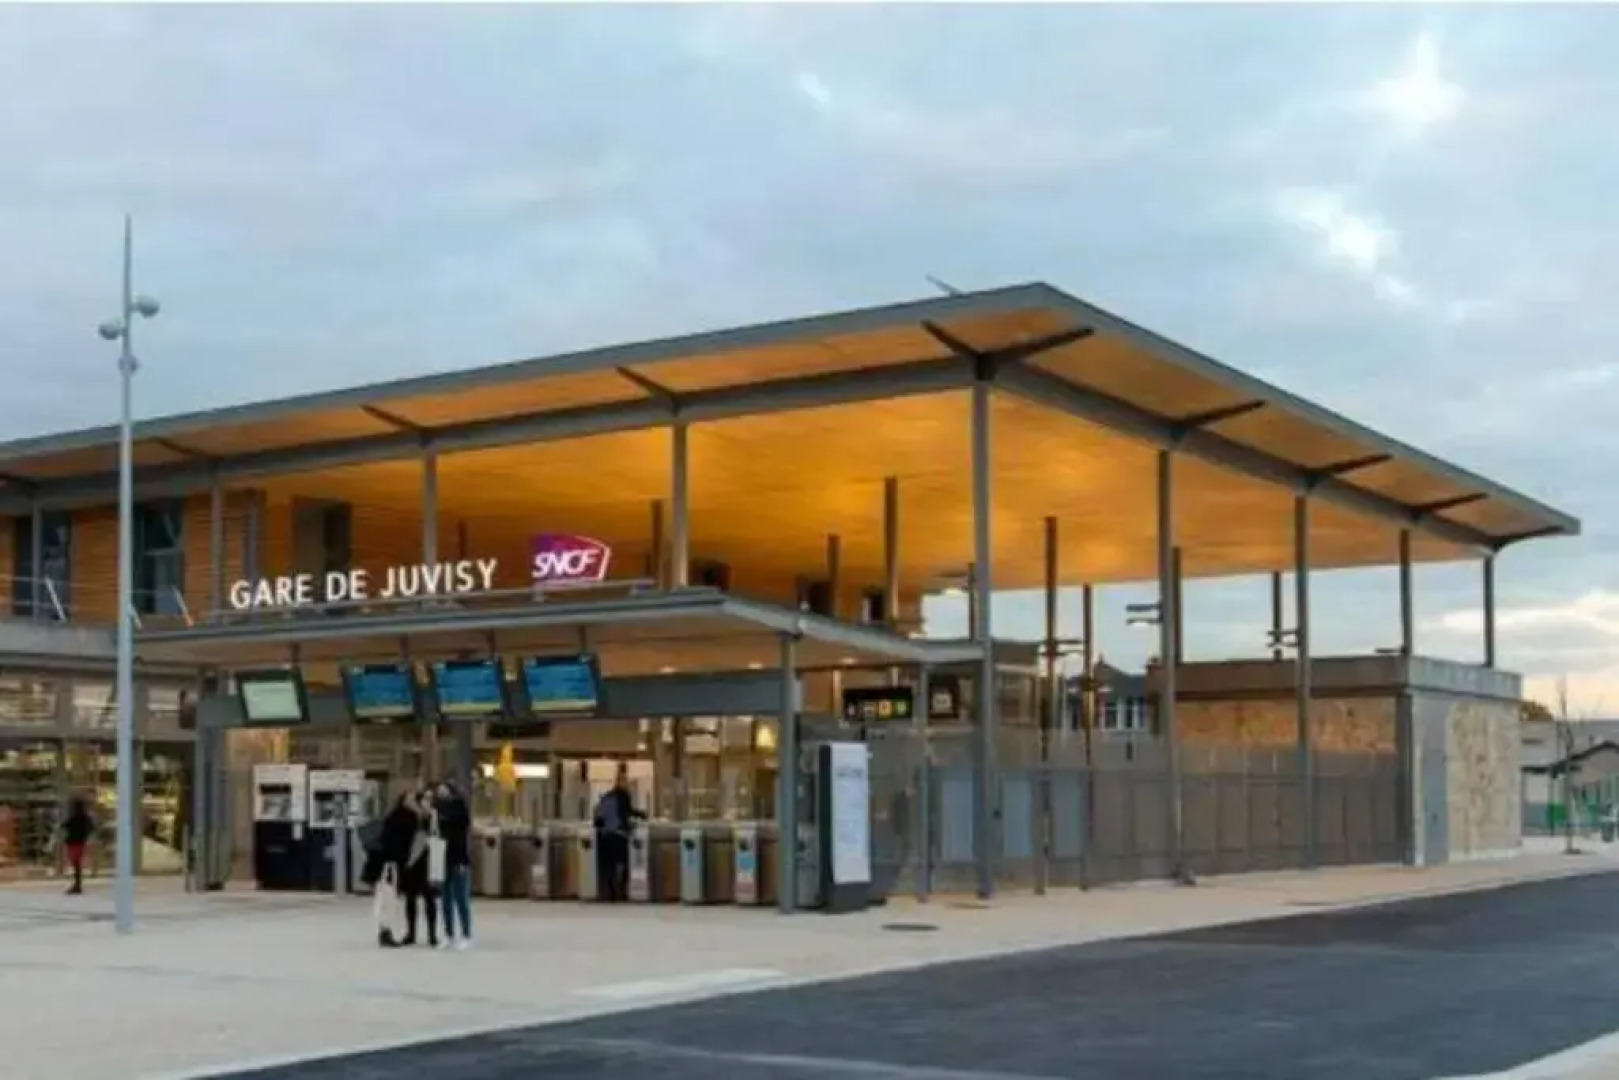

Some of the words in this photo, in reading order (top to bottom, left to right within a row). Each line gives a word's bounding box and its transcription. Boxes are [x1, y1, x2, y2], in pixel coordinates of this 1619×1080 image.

[532, 549, 600, 578] SNCF
[230, 575, 313, 610] GARE
[325, 569, 368, 602] DE
[380, 558, 498, 598] JUVISY
